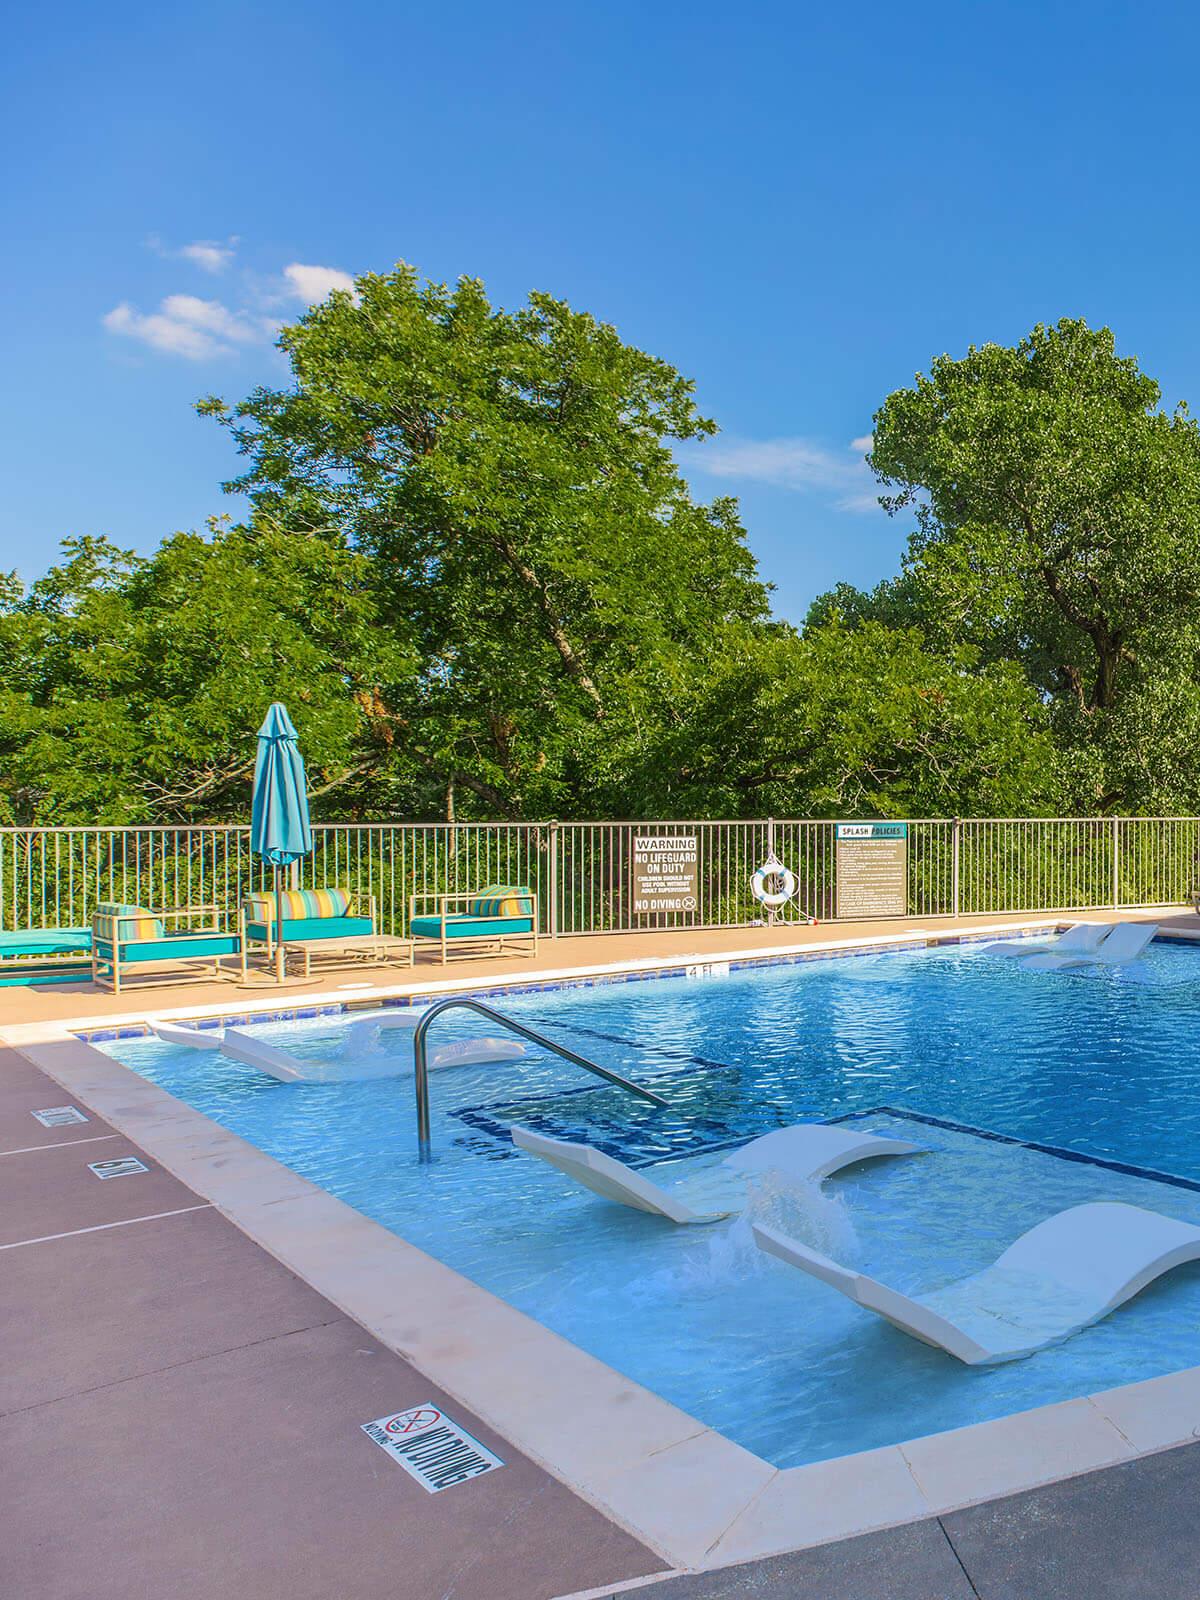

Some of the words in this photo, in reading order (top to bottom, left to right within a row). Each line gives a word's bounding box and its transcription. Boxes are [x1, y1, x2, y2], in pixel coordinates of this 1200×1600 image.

[843, 827, 869, 835] SPLASH
[872, 827, 901, 835] POLICIES
[637, 839, 695, 849] WARNING
[635, 852, 648, 863] NO
[650, 852, 697, 863] LIFEGUARD
[647, 863, 660, 873] ON
[662, 863, 685, 873] DUTY
[635, 899, 648, 910] NO
[650, 898, 681, 909] DIVING
[689, 966, 697, 977] 4
[392, 1425, 456, 1454] NO
[406, 1438, 492, 1489] DIVING
